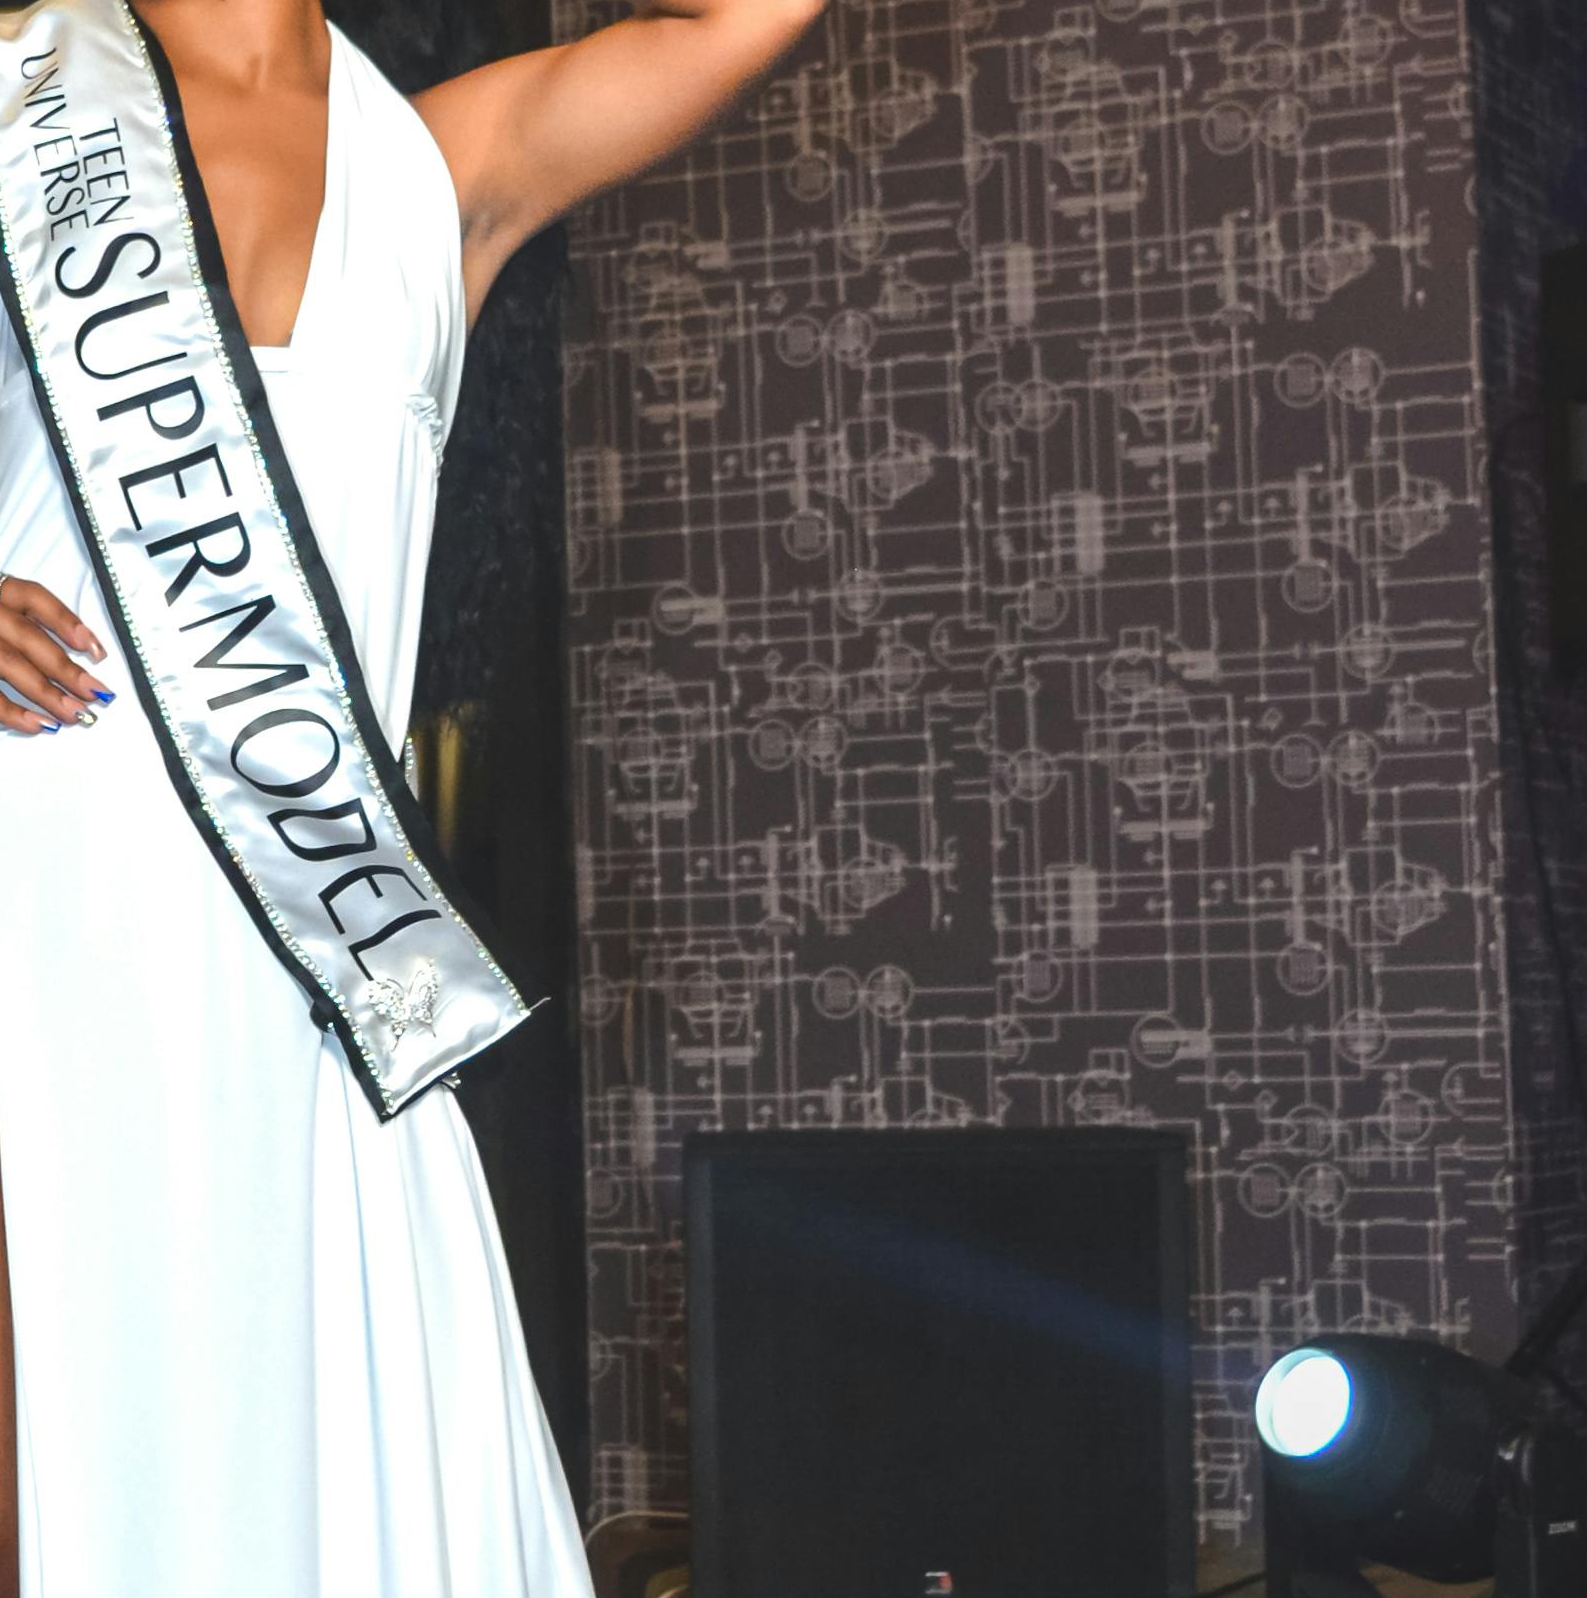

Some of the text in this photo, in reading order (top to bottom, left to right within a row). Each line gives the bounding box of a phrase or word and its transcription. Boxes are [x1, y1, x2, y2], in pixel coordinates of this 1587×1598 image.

[20, 47, 90, 242] UNIVERSE
[79, 117, 134, 226] TEEN
[54, 231, 442, 982] SUPERMODEL
